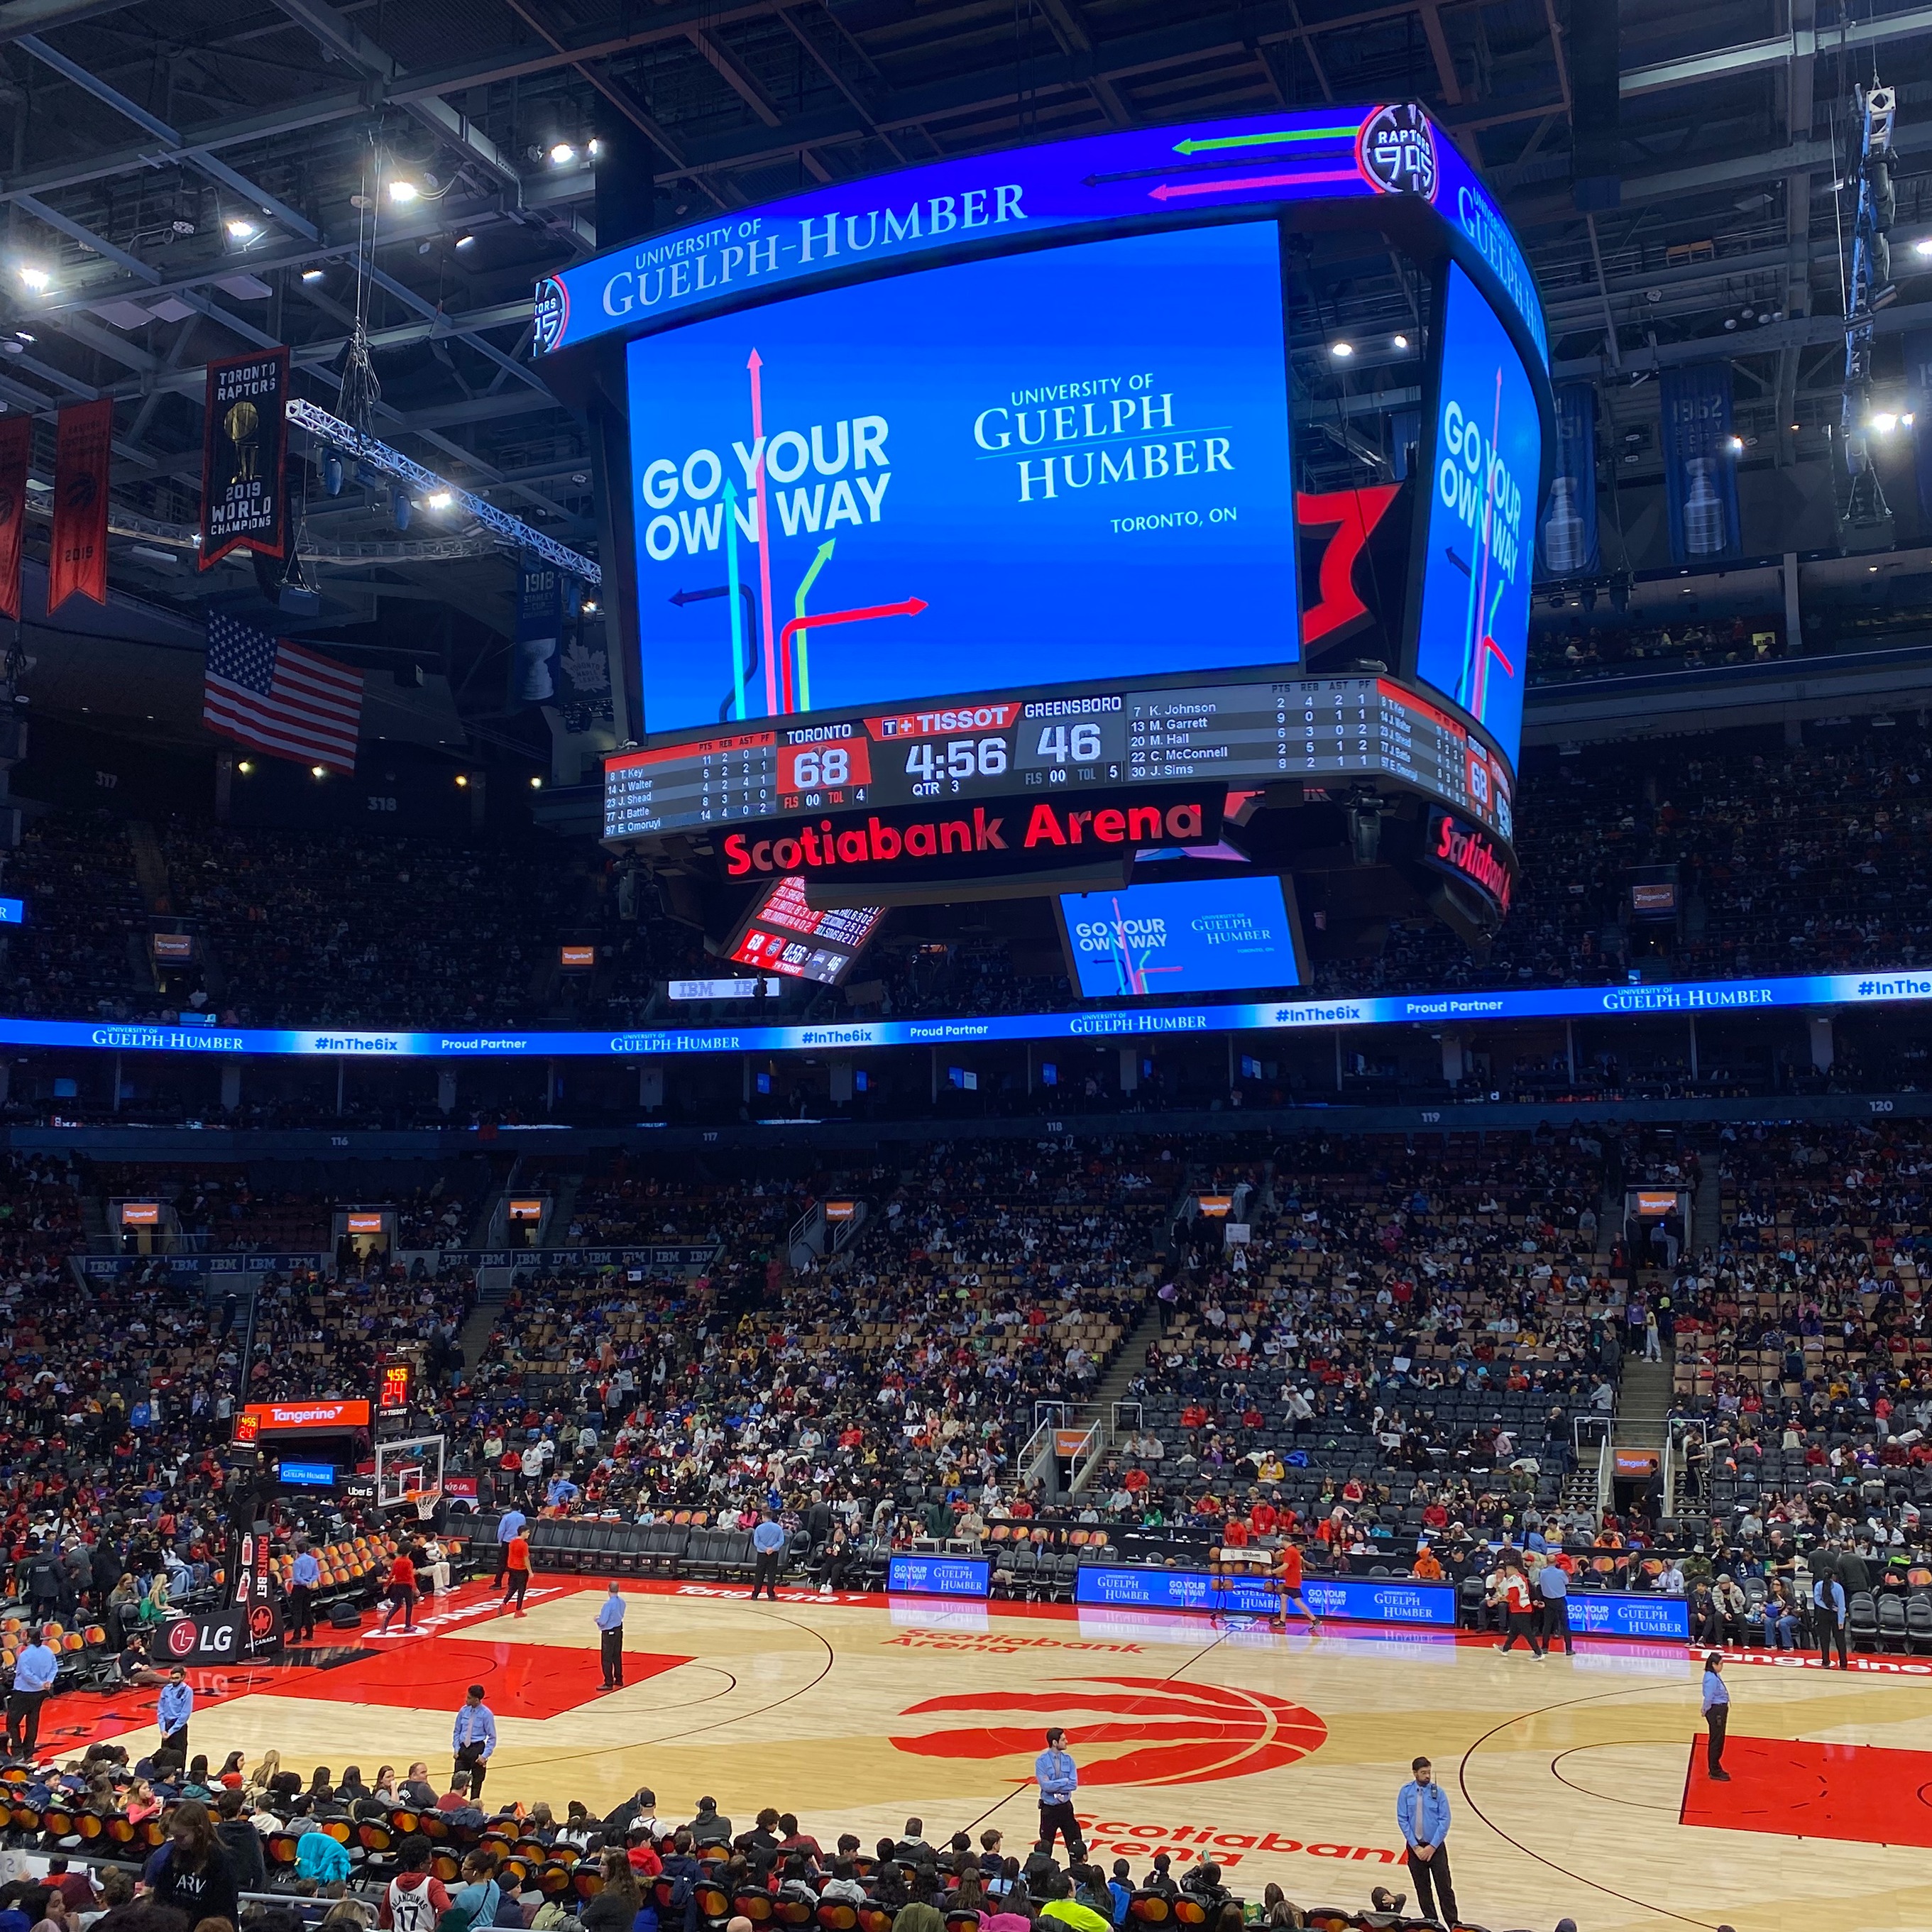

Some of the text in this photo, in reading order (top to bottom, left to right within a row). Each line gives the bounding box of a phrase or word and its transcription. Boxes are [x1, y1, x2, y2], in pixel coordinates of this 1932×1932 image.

[1378, 130, 1429, 155] RAPTORS
[1375, 145, 1432, 187] 905
[602, 184, 1028, 317] GUELPH-HUMBER
[635, 218, 762, 270] UNIVERSITY OF
[220, 362, 275, 385] TORONTO
[217, 378, 276, 400] RAPTORS
[1011, 373, 1153, 406] UNIVERSITY OF
[974, 393, 1175, 451] GUELPH
[642, 415, 890, 510] GO YOUR
[1017, 437, 1235, 503] HUMBER
[1444, 400, 1521, 541] GO YOUR
[226, 481, 261, 502] 2019
[212, 496, 271, 522] WORLD
[645, 472, 891, 561] OWN WAY
[211, 515, 271, 535] CHAMPIONS
[1111, 507, 1237, 533] TORONTO, ON
[1440, 458, 1518, 585] OWN WAY
[65, 546, 93, 561] 2019
[525, 571, 554, 593] 1918
[1272, 684, 1290, 693] PTS
[1300, 683, 1319, 691] REB
[1329, 681, 1349, 690] AST
[1024, 697, 1121, 718] GREENSBORO
[1134, 703, 1216, 717] 7 K. Johnson
[916, 707, 1009, 732] TISSOT
[1131, 718, 1207, 732] 13 M. Garrett
[787, 724, 851, 745] TORONTO
[1131, 733, 1189, 747] 20 M. Hall
[699, 743, 712, 752] PTS
[719, 740, 732, 748] REB
[739, 736, 753, 745] AST
[1037, 723, 1101, 763] 46
[905, 737, 1007, 780] 4:56
[1131, 747, 1228, 762] 22 C. McConnell
[610, 769, 644, 781] 8 T. Key
[794, 749, 848, 789] 68
[1025, 765, 1117, 786] FLS 00 TOL 5
[1131, 764, 1193, 777] 30 J. Sims
[608, 779, 652, 794] 14 J. Walter
[912, 781, 959, 796] QTR 3
[368, 796, 397, 811] 318
[607, 792, 652, 808] 23 J. Shead
[784, 789, 865, 808] FLS 00 TOL 4
[606, 806, 649, 821] 77 J. Battle
[605, 818, 661, 835] 97 E. Omoruyi
[725, 803, 1202, 874] Scotiabank Arena
[1076, 918, 1166, 938] GO YOUR
[1191, 918, 1252, 931] GUELPH
[747, 934, 765, 950] 68
[1079, 933, 1168, 951] OWN WAY
[1207, 930, 1271, 944] HUMBER
[782, 943, 806, 962] 4:56
[827, 956, 842, 972] 46
[679, 982, 714, 997] IBM
[1407, 999, 1503, 1014] Proud Partner
[1603, 989, 1773, 1009] GUELPH-HUMBER
[1275, 1006, 1360, 1023] #InThe6ix
[910, 1024, 988, 1037] Proud Partner
[1070, 1015, 1207, 1033] GUELPH-HUMBER
[92, 1030, 243, 1050] GUELPH-HUMBER
[314, 1037, 397, 1051] #InThe6ix
[442, 1039, 527, 1049] Proud Partner
[610, 1035, 740, 1051] GUELPH-HUMBER
[802, 1029, 872, 1044] #InThe6ix
[1869, 1101, 1892, 1112] 120
[1422, 1112, 1440, 1123] 119
[1047, 1122, 1063, 1131] 118
[331, 1136, 348, 1146] 116
[703, 1133, 718, 1141] 117
[89, 1261, 118, 1273] IBM
[480, 1254, 505, 1265] IBM
[383, 1381, 403, 1405] 24
[271, 1408, 335, 1424] Tangerine
[348, 1486, 366, 1496] Uber
[257, 1535, 268, 1598] POINTSBET
[1097, 1576, 1139, 1588] GUELPH
[1105, 1589, 1149, 1601] HUMBER
[1374, 1593, 1420, 1606] GUELPH
[1384, 1606, 1432, 1618] HUMBER
[1584, 1605, 1609, 1613] YOUR
[1618, 1607, 1667, 1620] GUELPH
[1629, 1621, 1681, 1632] HUMBER
[199, 1625, 233, 1651] LG
[255, 1635, 277, 1646] CANADA
[879, 1637, 1020, 1654] Arena
[899, 1629, 1149, 1654] Scotiabank
[397, 1906, 418, 1931] 17
